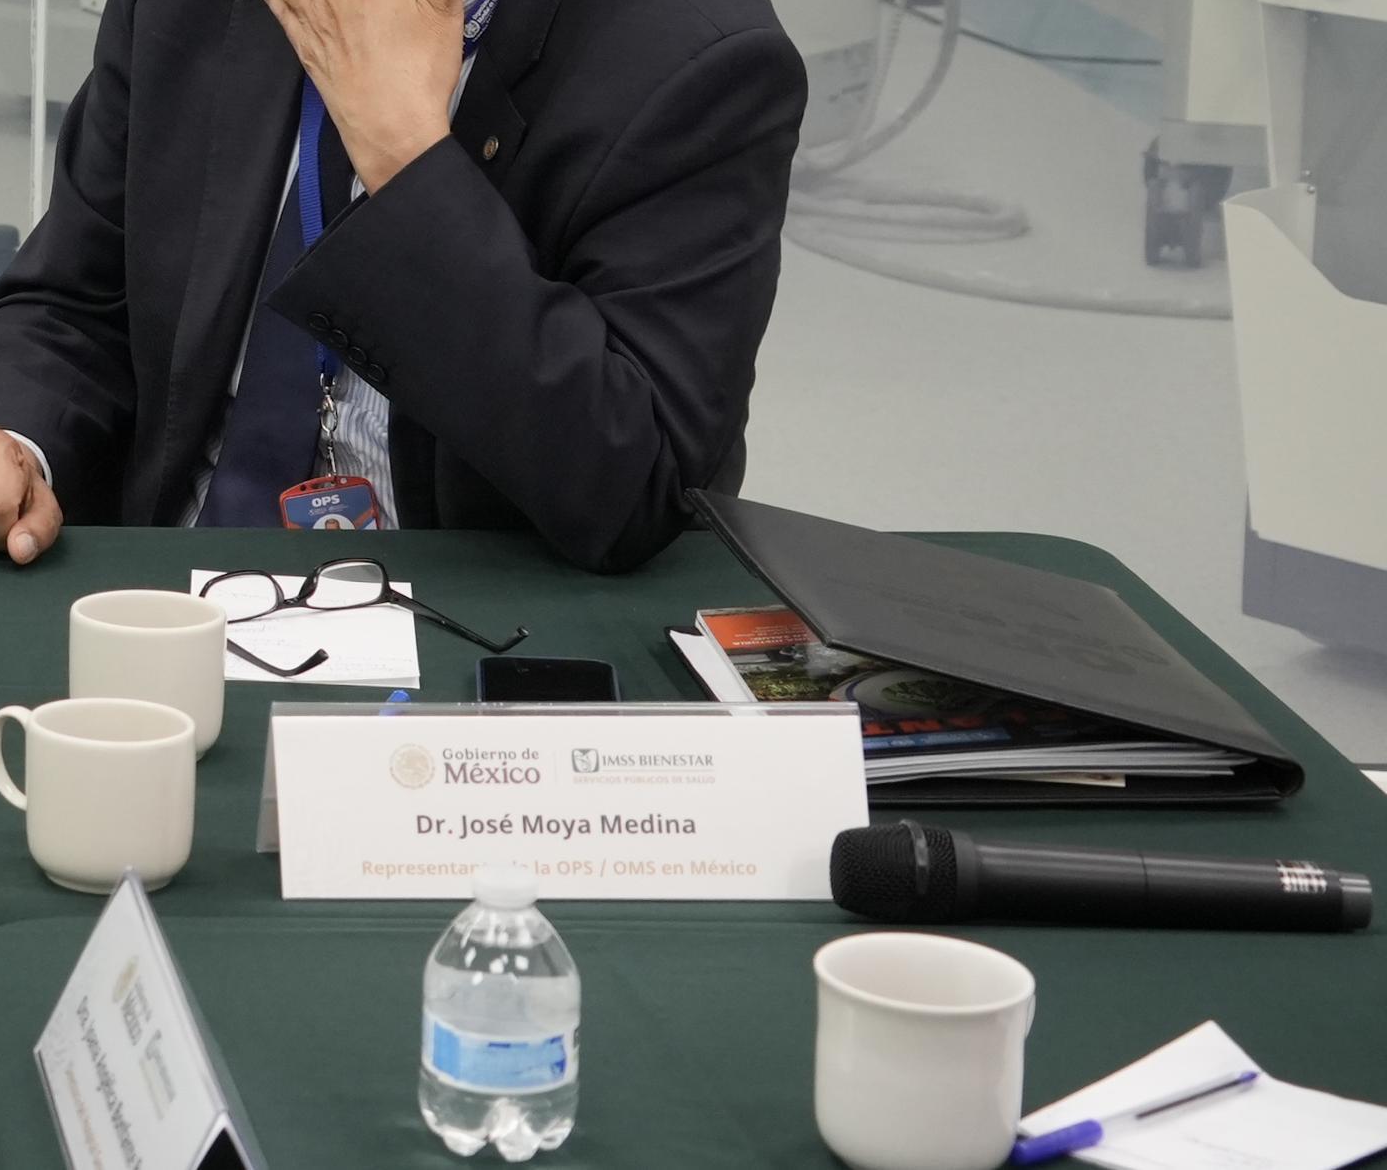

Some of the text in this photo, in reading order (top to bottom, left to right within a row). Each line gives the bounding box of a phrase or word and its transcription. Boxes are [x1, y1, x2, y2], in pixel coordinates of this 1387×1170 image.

[312, 494, 340, 508] OPS
[443, 748, 539, 760] Gobierno de
[602, 754, 714, 766] IMSS BIENESTAR
[444, 762, 541, 785] México
[416, 814, 697, 839] Dr. José Moya Medina
[362, 860, 487, 877] Representa
[534, 859, 552, 875] la
[557, 860, 594, 876] OPS
[613, 861, 657, 876] OMS
[662, 864, 684, 876] en
[690, 859, 758, 876] México
